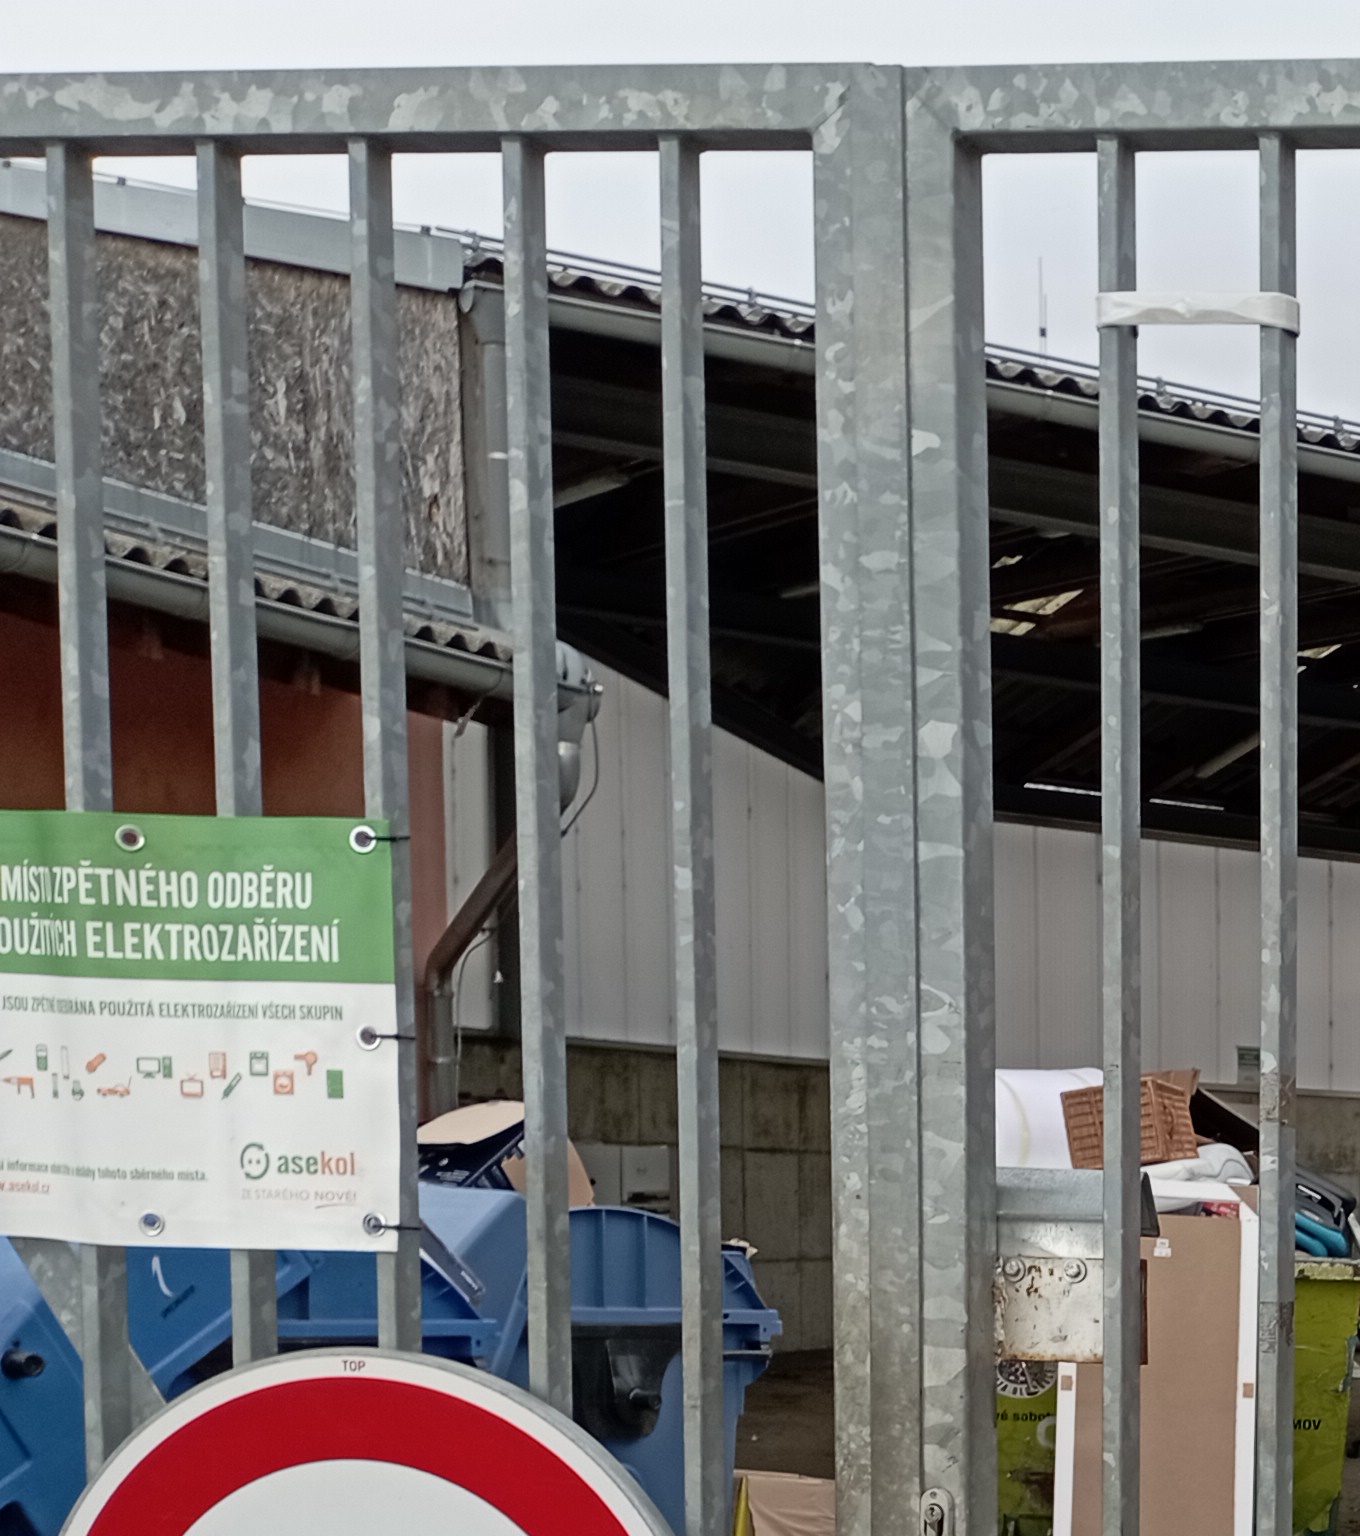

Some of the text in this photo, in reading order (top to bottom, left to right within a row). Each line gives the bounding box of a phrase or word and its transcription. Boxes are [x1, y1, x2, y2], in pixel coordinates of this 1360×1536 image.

[0, 859, 312, 909] MÍSTO ZPĚTNÉHO ODBĚRU
[85, 917, 340, 963] ELEKTROZAŘÍZENÍ
[99, 998, 155, 1017] POUŽITÁ
[159, 1001, 258, 1019] ELEKTROZAŘÍZENÍ
[261, 1001, 296, 1020] VŠECH
[300, 1005, 344, 1021] SKUPIN
[277, 1151, 356, 1176] asekol
[341, 1359, 366, 1371] TOP
